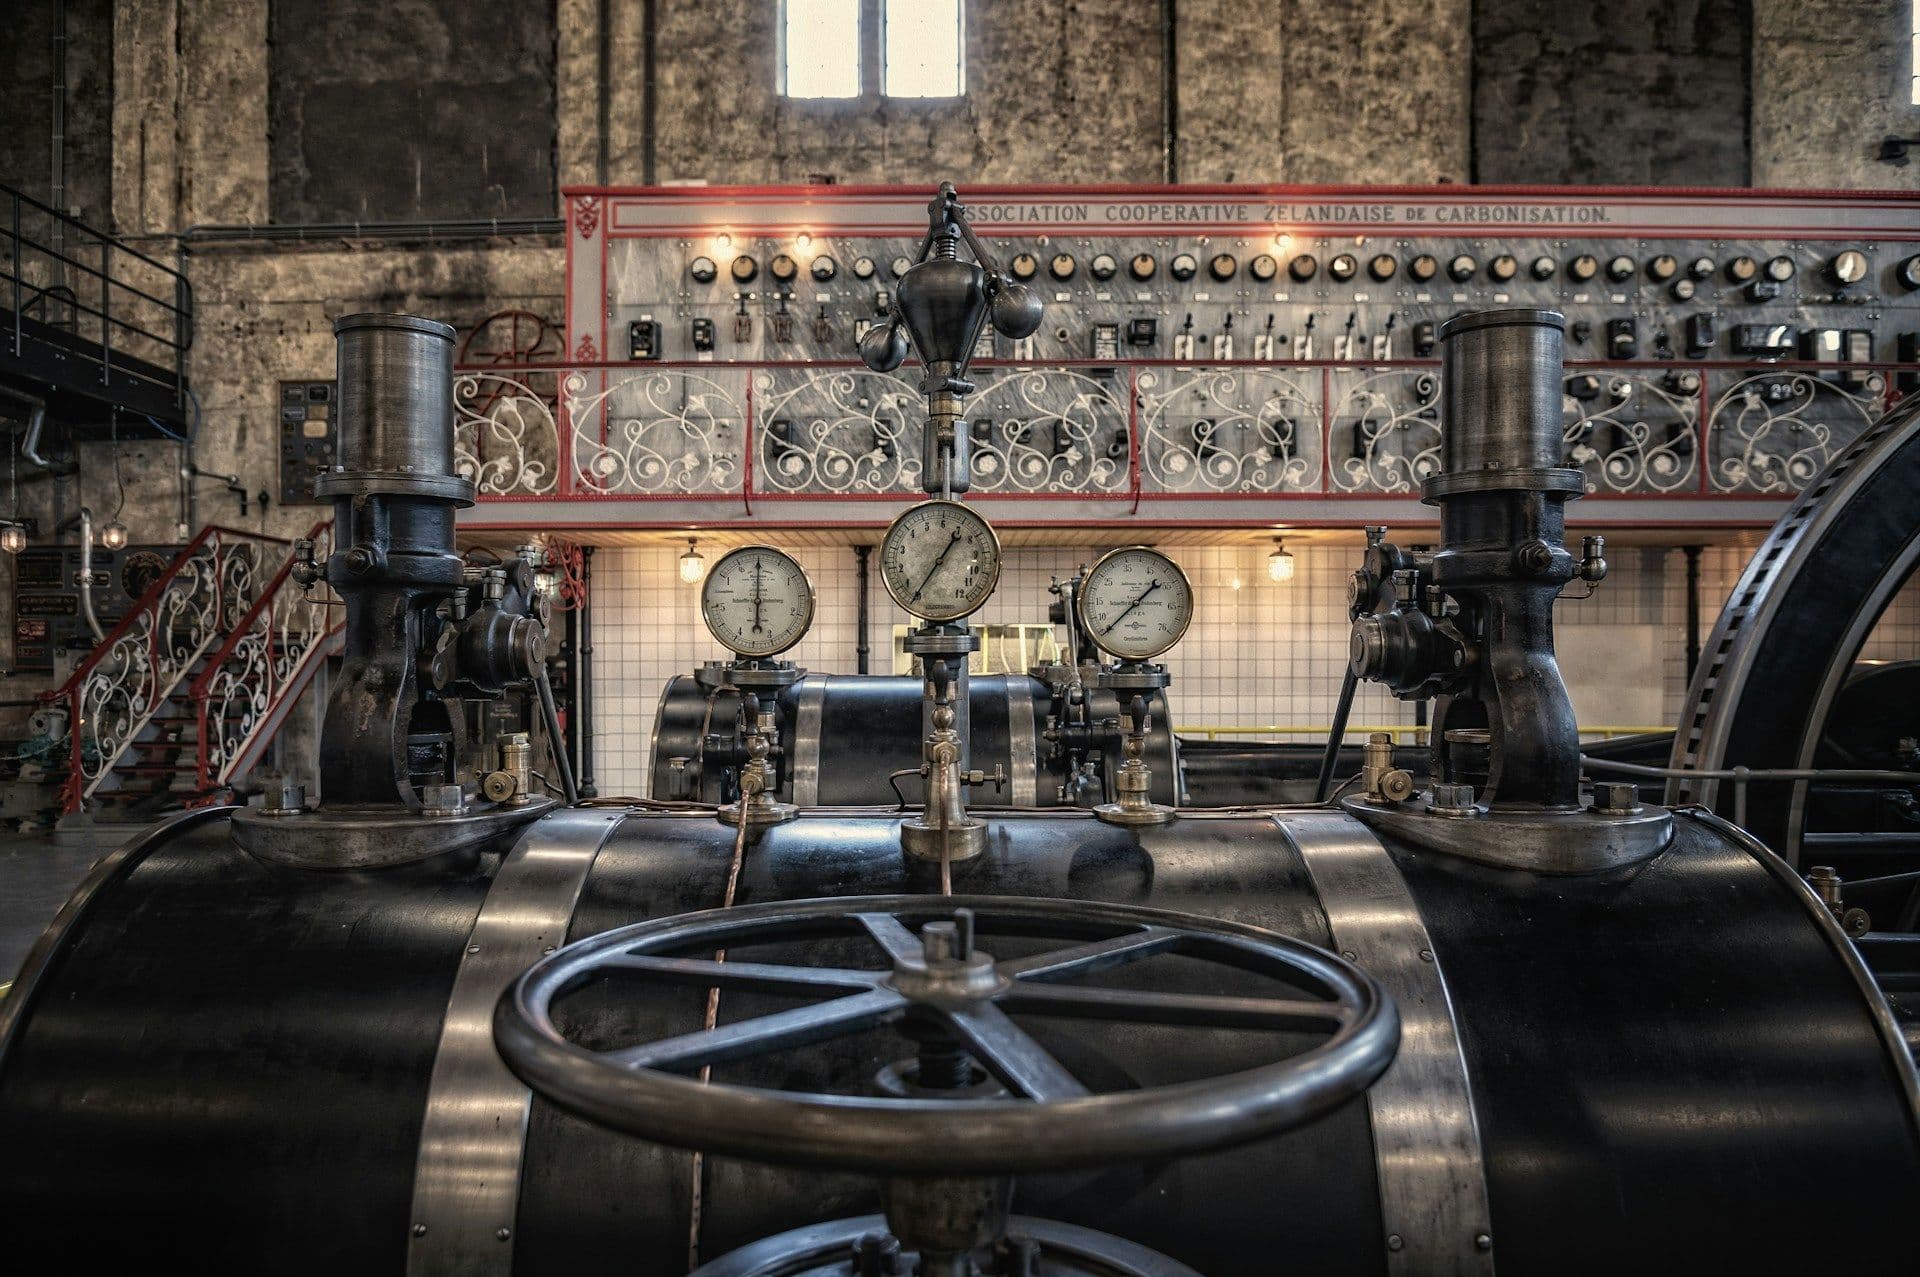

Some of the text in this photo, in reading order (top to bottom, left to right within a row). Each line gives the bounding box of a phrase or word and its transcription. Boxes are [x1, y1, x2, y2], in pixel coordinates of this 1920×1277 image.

[962, 204, 1612, 223] SSOCIATION COOPERATIVE ZELANDAISE DE CARBONISATION.
[955, 589, 965, 599] 12
